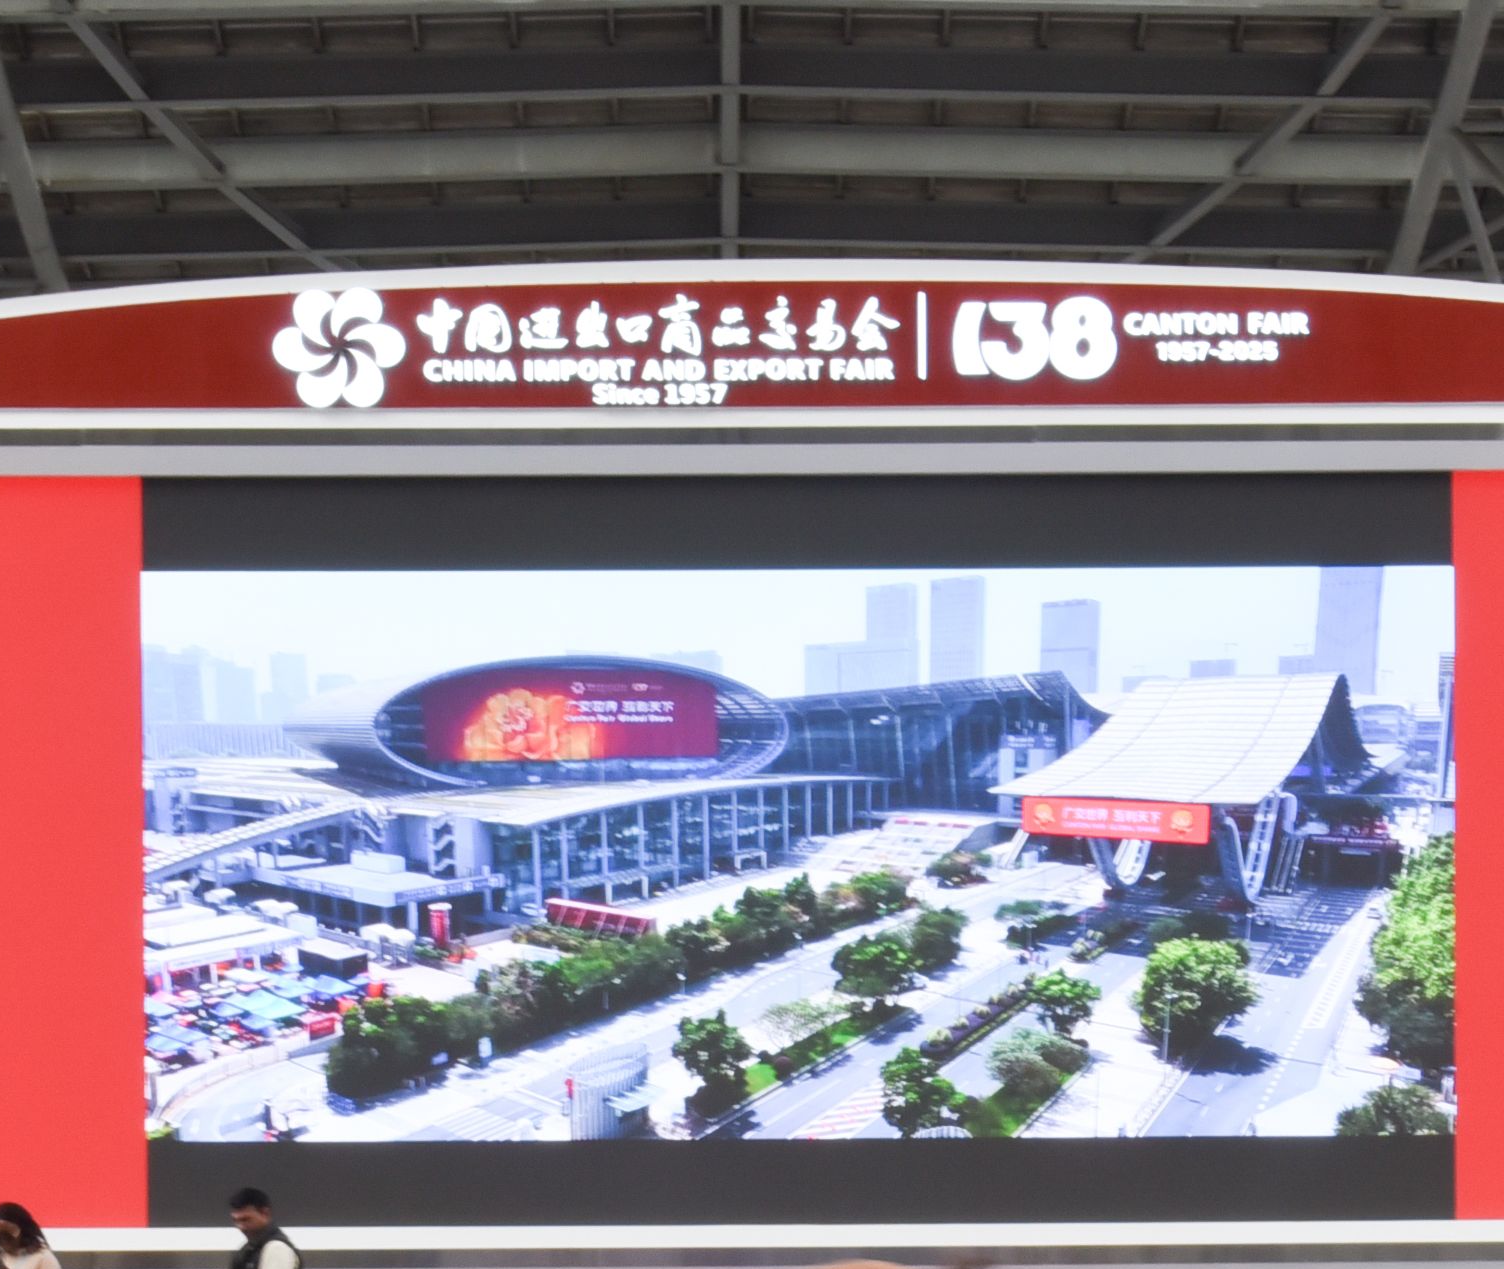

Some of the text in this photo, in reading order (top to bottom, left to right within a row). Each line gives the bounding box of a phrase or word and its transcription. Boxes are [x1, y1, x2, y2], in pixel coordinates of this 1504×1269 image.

[416, 294, 900, 355] 中国进出口商品交易会
[1122, 311, 1310, 337] CANTON FAIR
[952, 295, 1118, 381] 138
[1155, 338, 1279, 362] 1957-2025
[422, 356, 895, 383] CHINA IMPORT AND EXPORT FAIR
[591, 382, 729, 405] Since 1957
